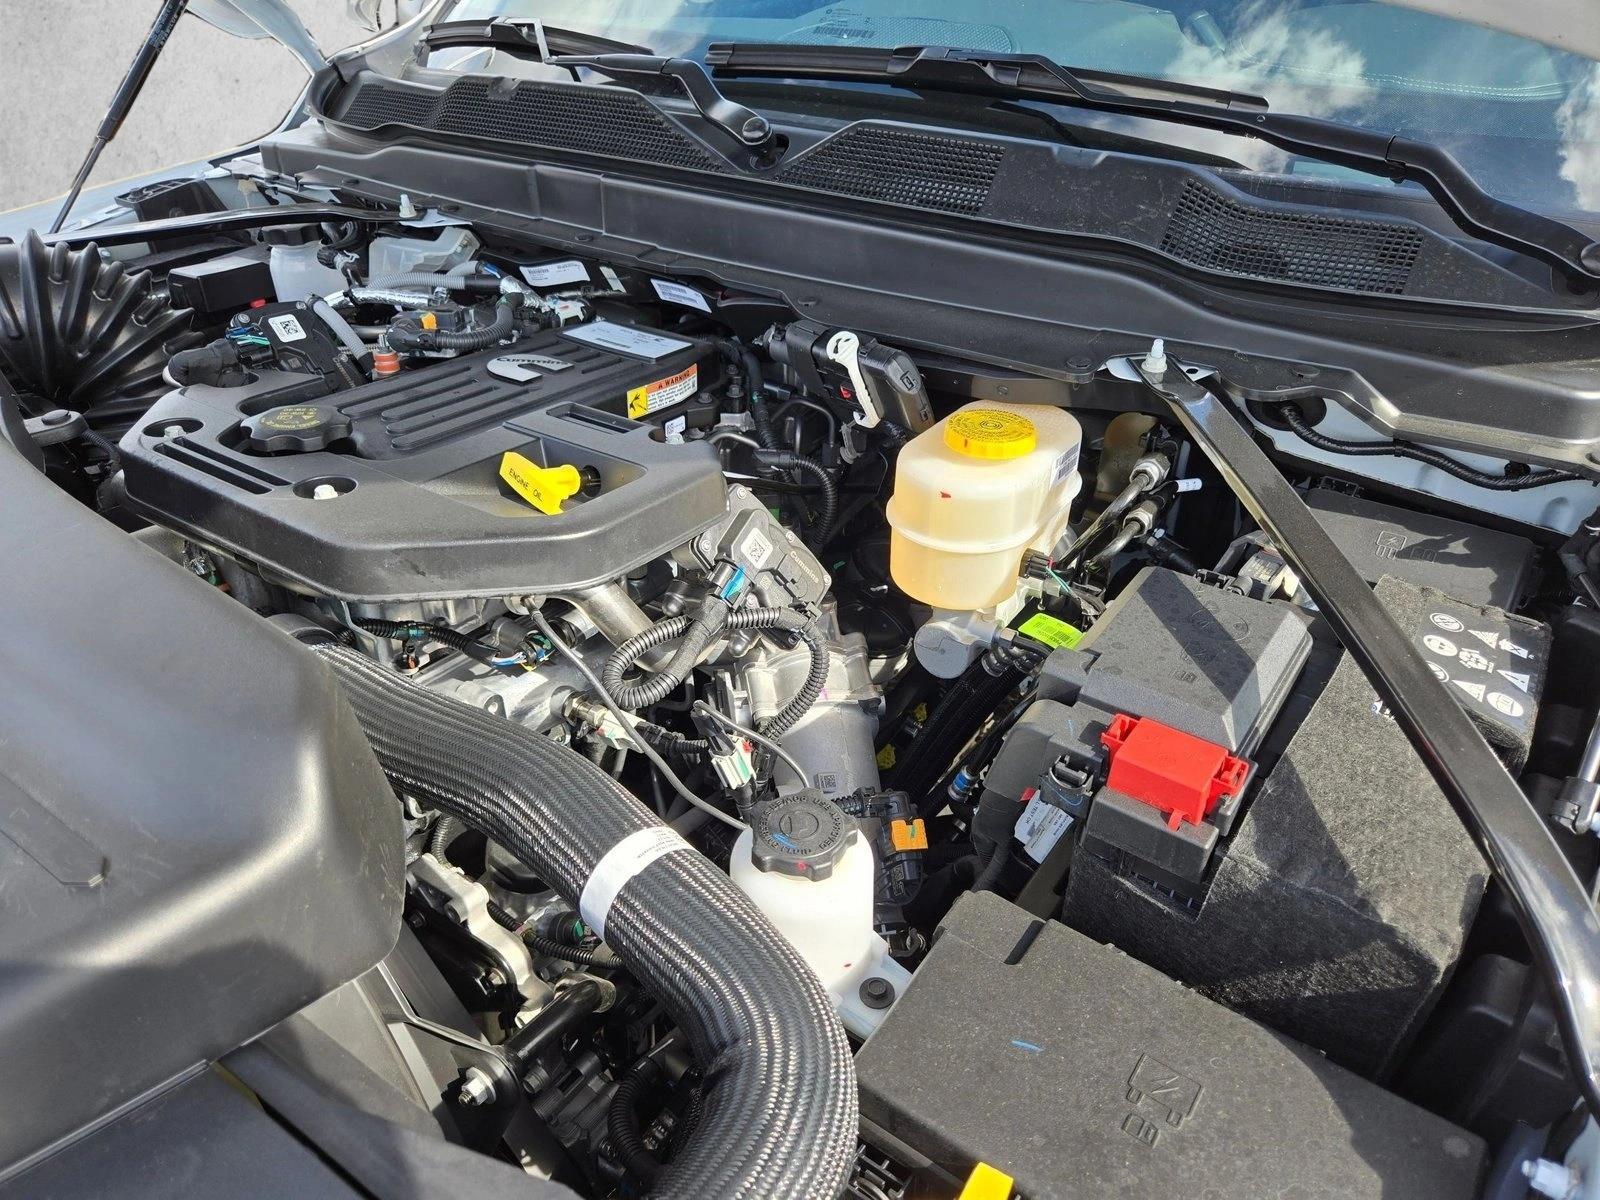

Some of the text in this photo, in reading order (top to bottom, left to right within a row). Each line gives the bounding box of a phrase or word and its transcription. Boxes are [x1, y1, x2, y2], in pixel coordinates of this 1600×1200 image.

[665, 370, 690, 386] WARNING
[509, 467, 544, 502] ENGINE OIL
[790, 551, 819, 584] Cummins
[813, 798, 831, 811] USE
